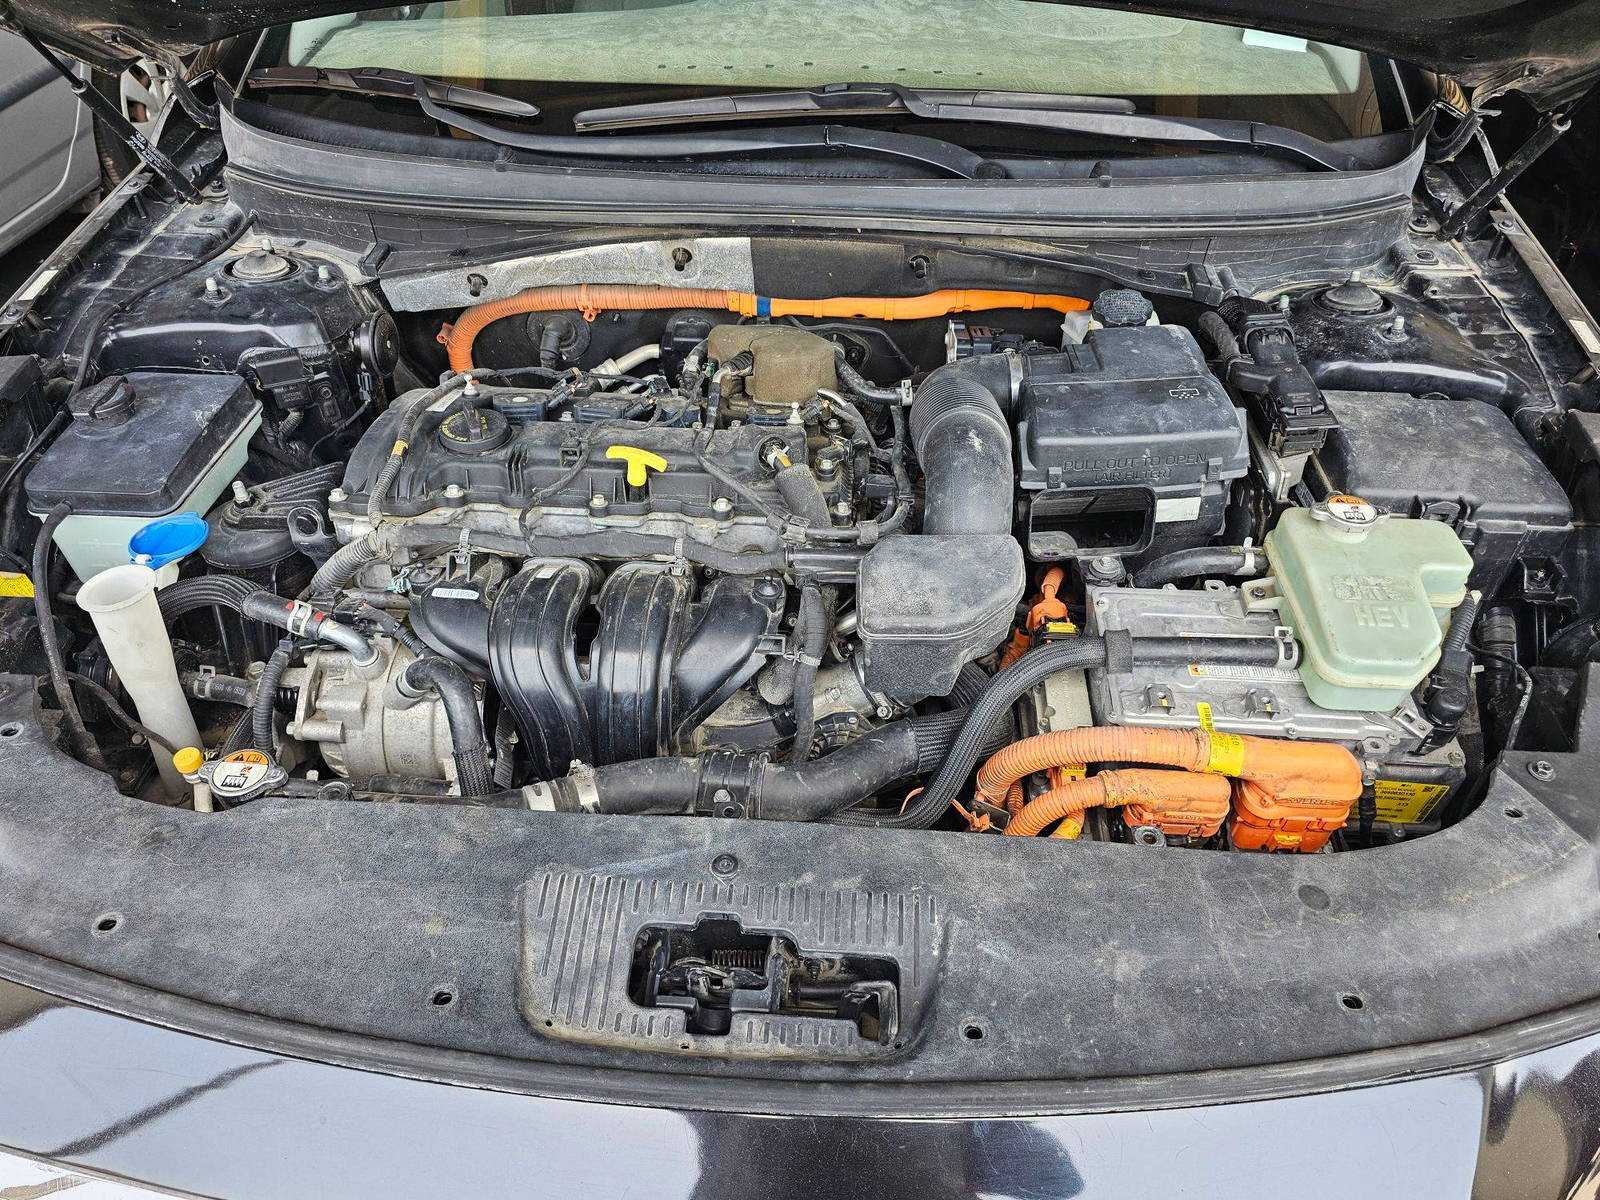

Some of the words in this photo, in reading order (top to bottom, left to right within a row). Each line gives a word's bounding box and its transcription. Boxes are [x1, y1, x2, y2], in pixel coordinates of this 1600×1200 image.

[1063, 459, 1102, 472] PULL
[1105, 457, 1139, 470] OUT
[1143, 456, 1162, 468] TO
[1165, 452, 1208, 466] OPEN
[1353, 605, 1409, 628] HEV
